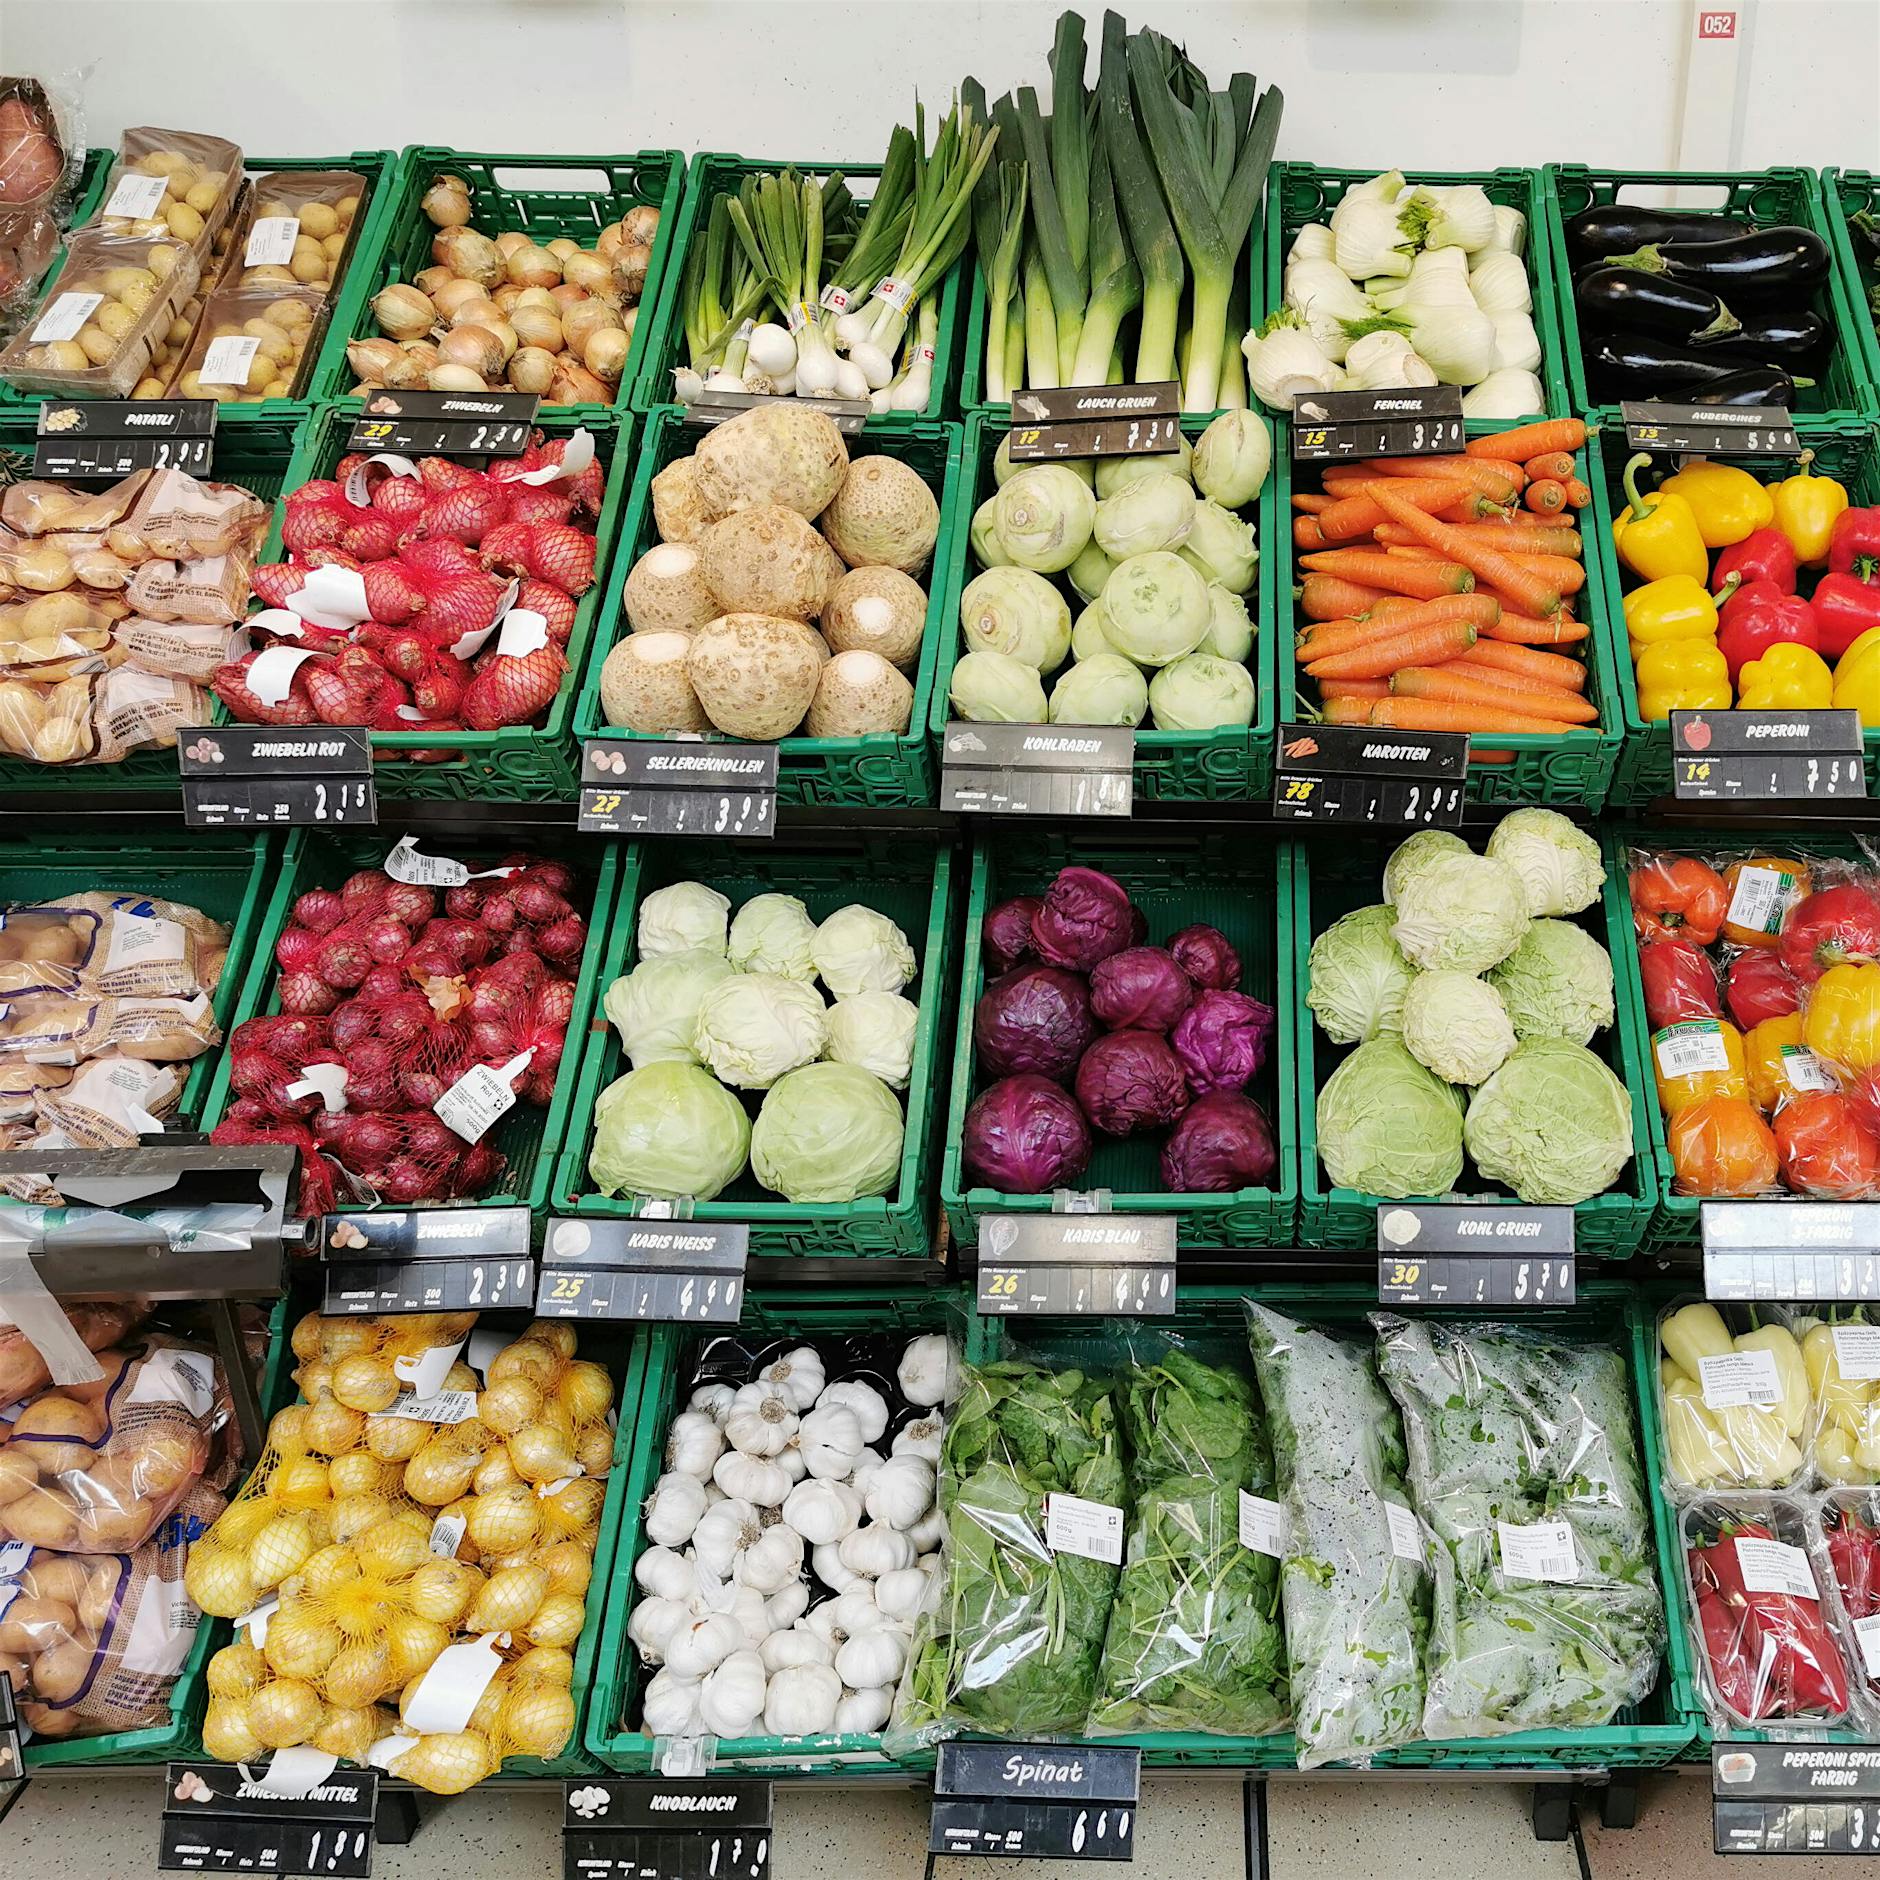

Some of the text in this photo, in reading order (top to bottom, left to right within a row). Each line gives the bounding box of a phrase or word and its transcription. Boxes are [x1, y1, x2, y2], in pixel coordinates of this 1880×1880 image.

[1705, 16, 1731, 34] 052
[441, 400, 504, 413] ZWIEBELN
[1077, 396, 1157, 409] LAUCH GRUEN
[1373, 400, 1423, 410] FENCHEL
[125, 413, 175, 426] PATATLI
[1692, 411, 1762, 423] AUBERGINES
[364, 424, 393, 437] 29
[1019, 430, 1041, 445] 17
[1305, 431, 1327, 446] 15
[1638, 428, 1658, 439] 13
[1745, 724, 1810, 738] PEPERONI
[251, 742, 347, 757] ZWIEBELN ROT
[1022, 736, 1102, 753] KOHLRABEN
[1362, 743, 1431, 762] KAROTTEN
[646, 756, 765, 774] SELLERIEKNOLLEN
[1686, 763, 1711, 781] 14
[1808, 759, 1857, 793] 7.50
[1285, 782, 1314, 800] 78
[274, 804, 290, 814] 250
[314, 783, 366, 821] 2.15
[591, 795, 622, 814] 27
[1404, 787, 1459, 823] 2.95
[714, 796, 769, 833] 3.95
[476, 1068, 510, 1102] ZWIEBELN
[480, 1085, 493, 1098] Rot
[465, 1118, 481, 1134] 500g
[1791, 1208, 1854, 1222] PEPERONI
[417, 1223, 486, 1239] ZWIEBELN
[1063, 1228, 1141, 1244] KABIS BLAU
[1457, 1220, 1542, 1237] KOHL GRUEN
[628, 1233, 716, 1251] KABIS WEISS
[1390, 1264, 1420, 1284] 30
[1515, 1263, 1569, 1300] 5.70
[469, 1264, 526, 1305] 2.30
[551, 1278, 584, 1298] 25
[989, 1274, 1018, 1294] 26
[425, 1289, 441, 1299] 500
[1782, 1752, 1847, 1767] PEPERONI
[1002, 1755, 1083, 1786] Spinat
[1811, 1770, 1859, 1786] FARBIG
[309, 1785, 359, 1802] MITTEL
[650, 1795, 738, 1812] KNOBLAUCH
[1006, 1830, 1023, 1842] 500
[1809, 1829, 1824, 1841] 500
[260, 1849, 278, 1860] 500
[308, 1830, 365, 1870] 1.80
